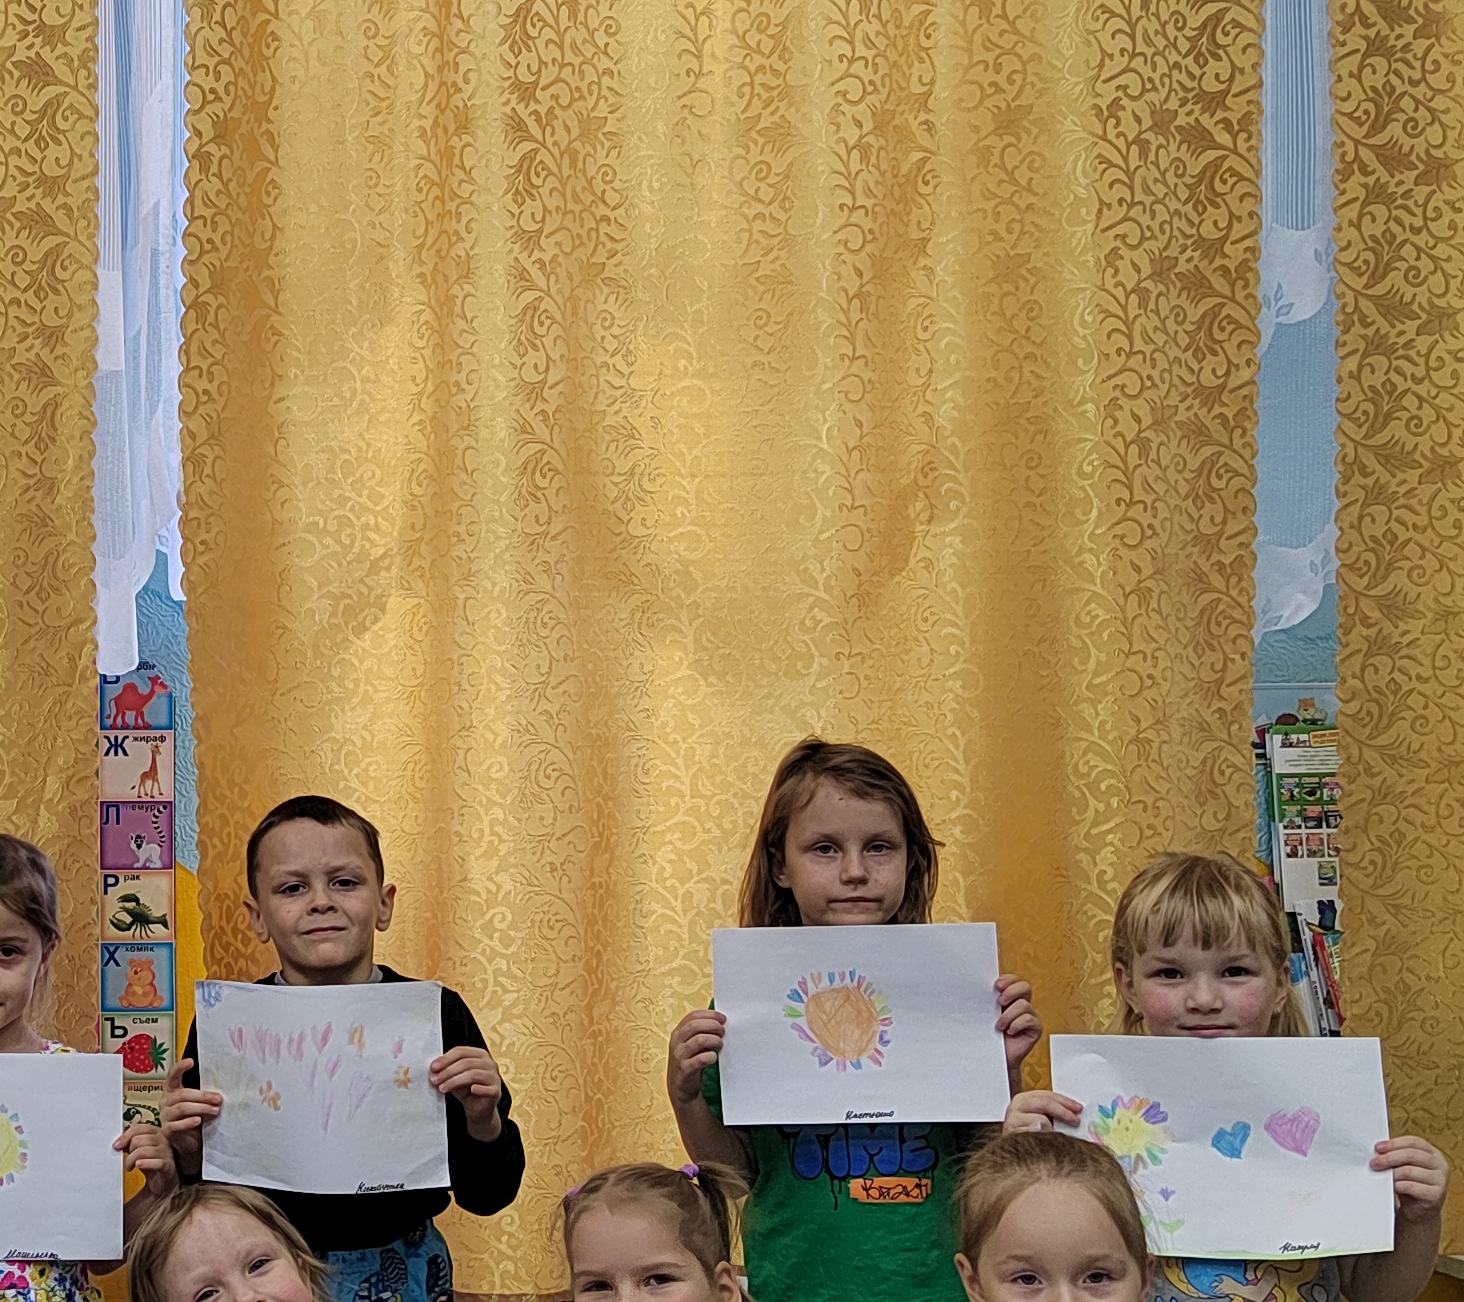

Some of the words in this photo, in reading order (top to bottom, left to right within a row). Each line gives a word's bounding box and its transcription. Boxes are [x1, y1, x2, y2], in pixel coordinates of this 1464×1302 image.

[103, 734, 130, 757] Ж
[131, 733, 167, 744] жираф
[102, 803, 121, 826] Л
[103, 873, 120, 896] Р
[123, 873, 141, 883] рак
[102, 945, 122, 968] Х
[124, 945, 156, 953] хомяк
[103, 1016, 129, 1039] Ъ
